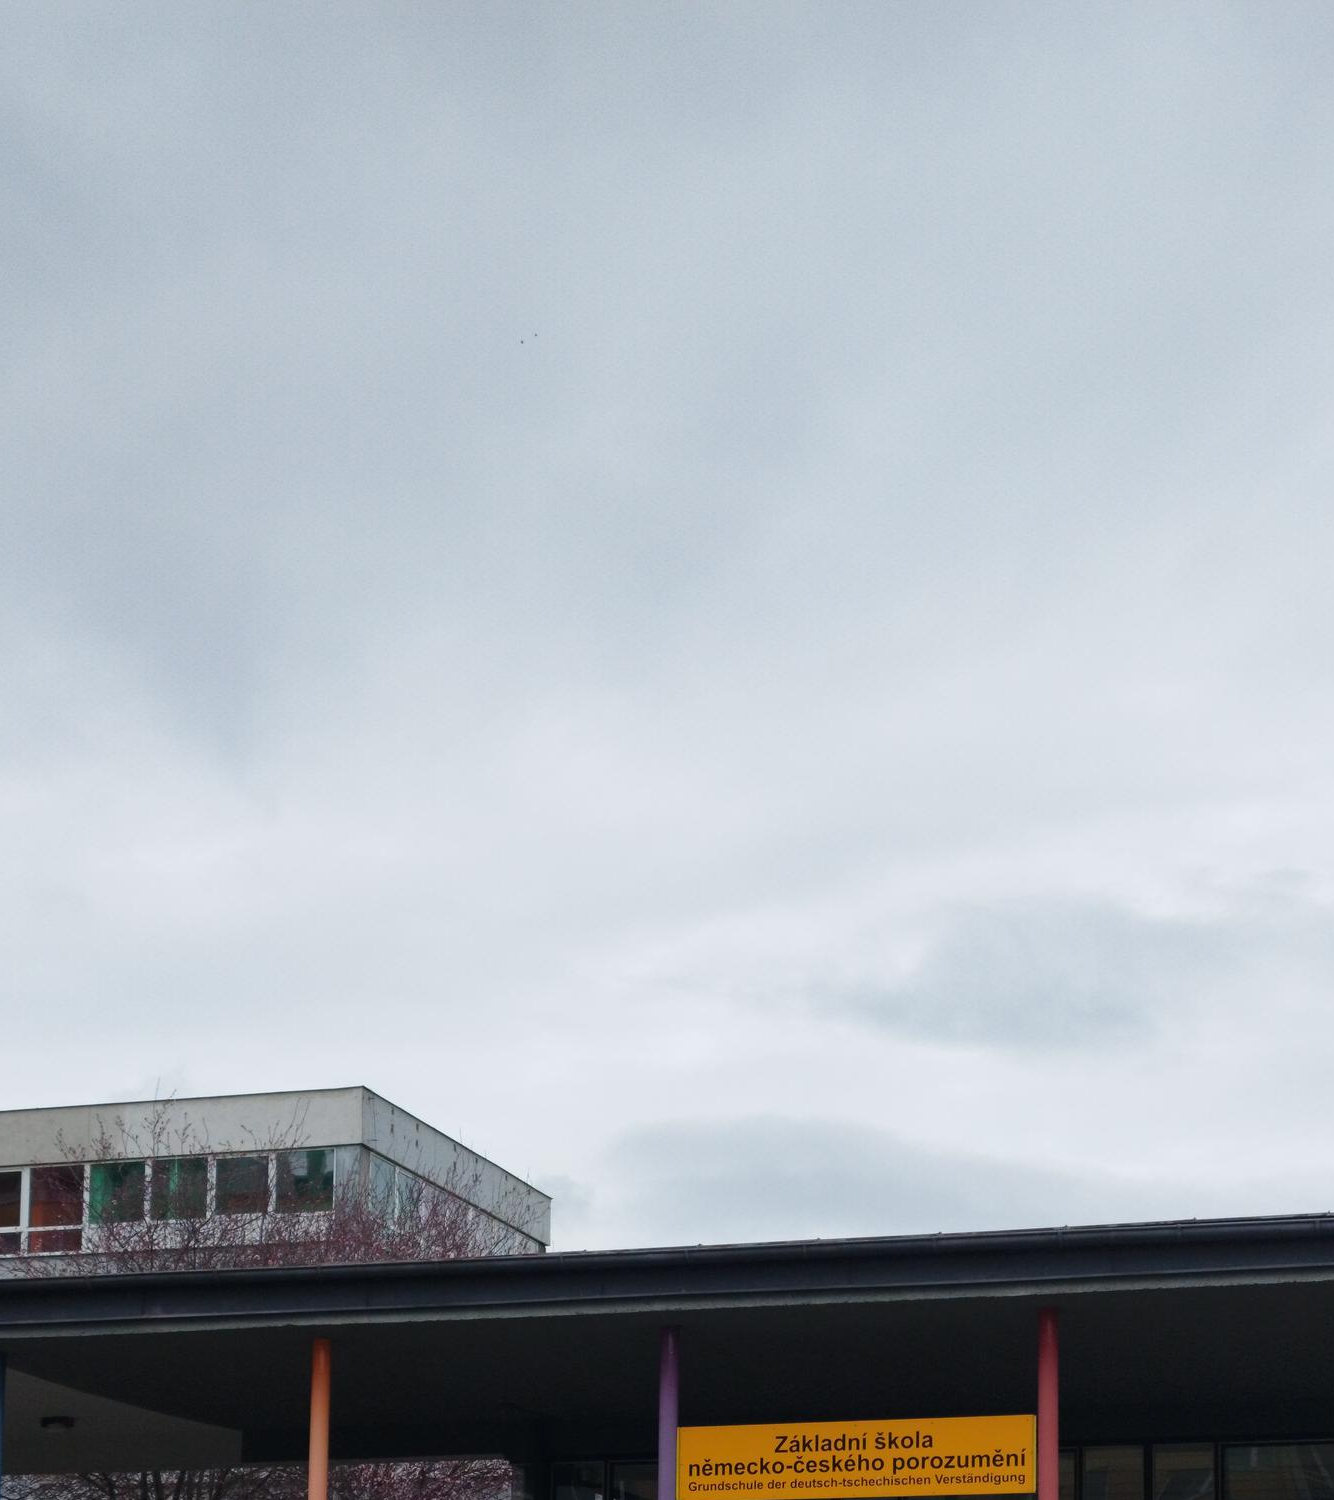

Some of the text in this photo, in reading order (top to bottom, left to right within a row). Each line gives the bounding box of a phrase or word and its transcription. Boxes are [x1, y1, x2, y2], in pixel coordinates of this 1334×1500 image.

[774, 1431, 933, 1453] Základní škola
[688, 1448, 1026, 1476] německo-českého porozumění
[688, 1472, 1026, 1492] Grundschule der deutsch-tschechischen Verständigung
